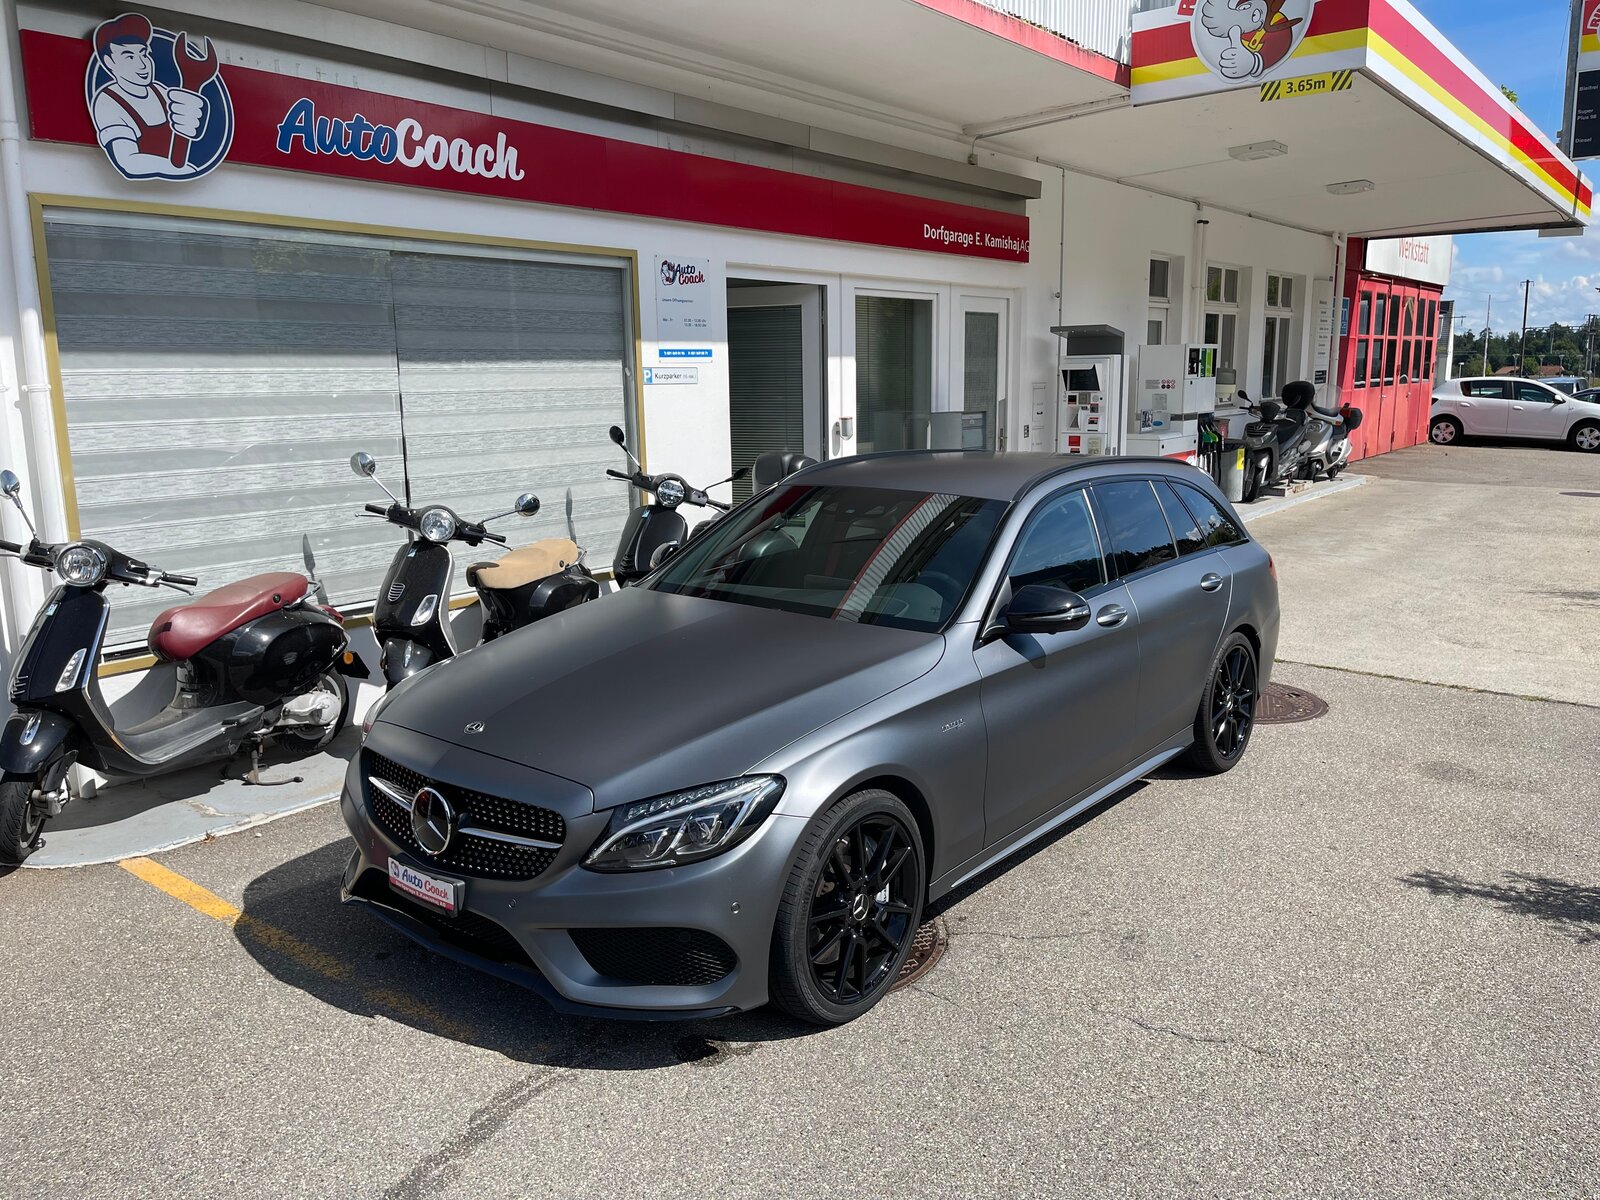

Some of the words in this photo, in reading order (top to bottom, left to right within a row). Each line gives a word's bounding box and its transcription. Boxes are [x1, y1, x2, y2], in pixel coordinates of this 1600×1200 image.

[1286, 79, 1326, 94] 3.65m
[277, 97, 526, 181] AutoCoach
[923, 223, 974, 248] Dorfgarage
[975, 232, 983, 246] E.
[1398, 237, 1429, 265] Werkstatt
[676, 263, 696, 275] Auto
[678, 270, 706, 286] Coach
[654, 372, 682, 380] Kurzparker
[402, 868, 423, 889] Auto
[424, 880, 449, 900] Coach
